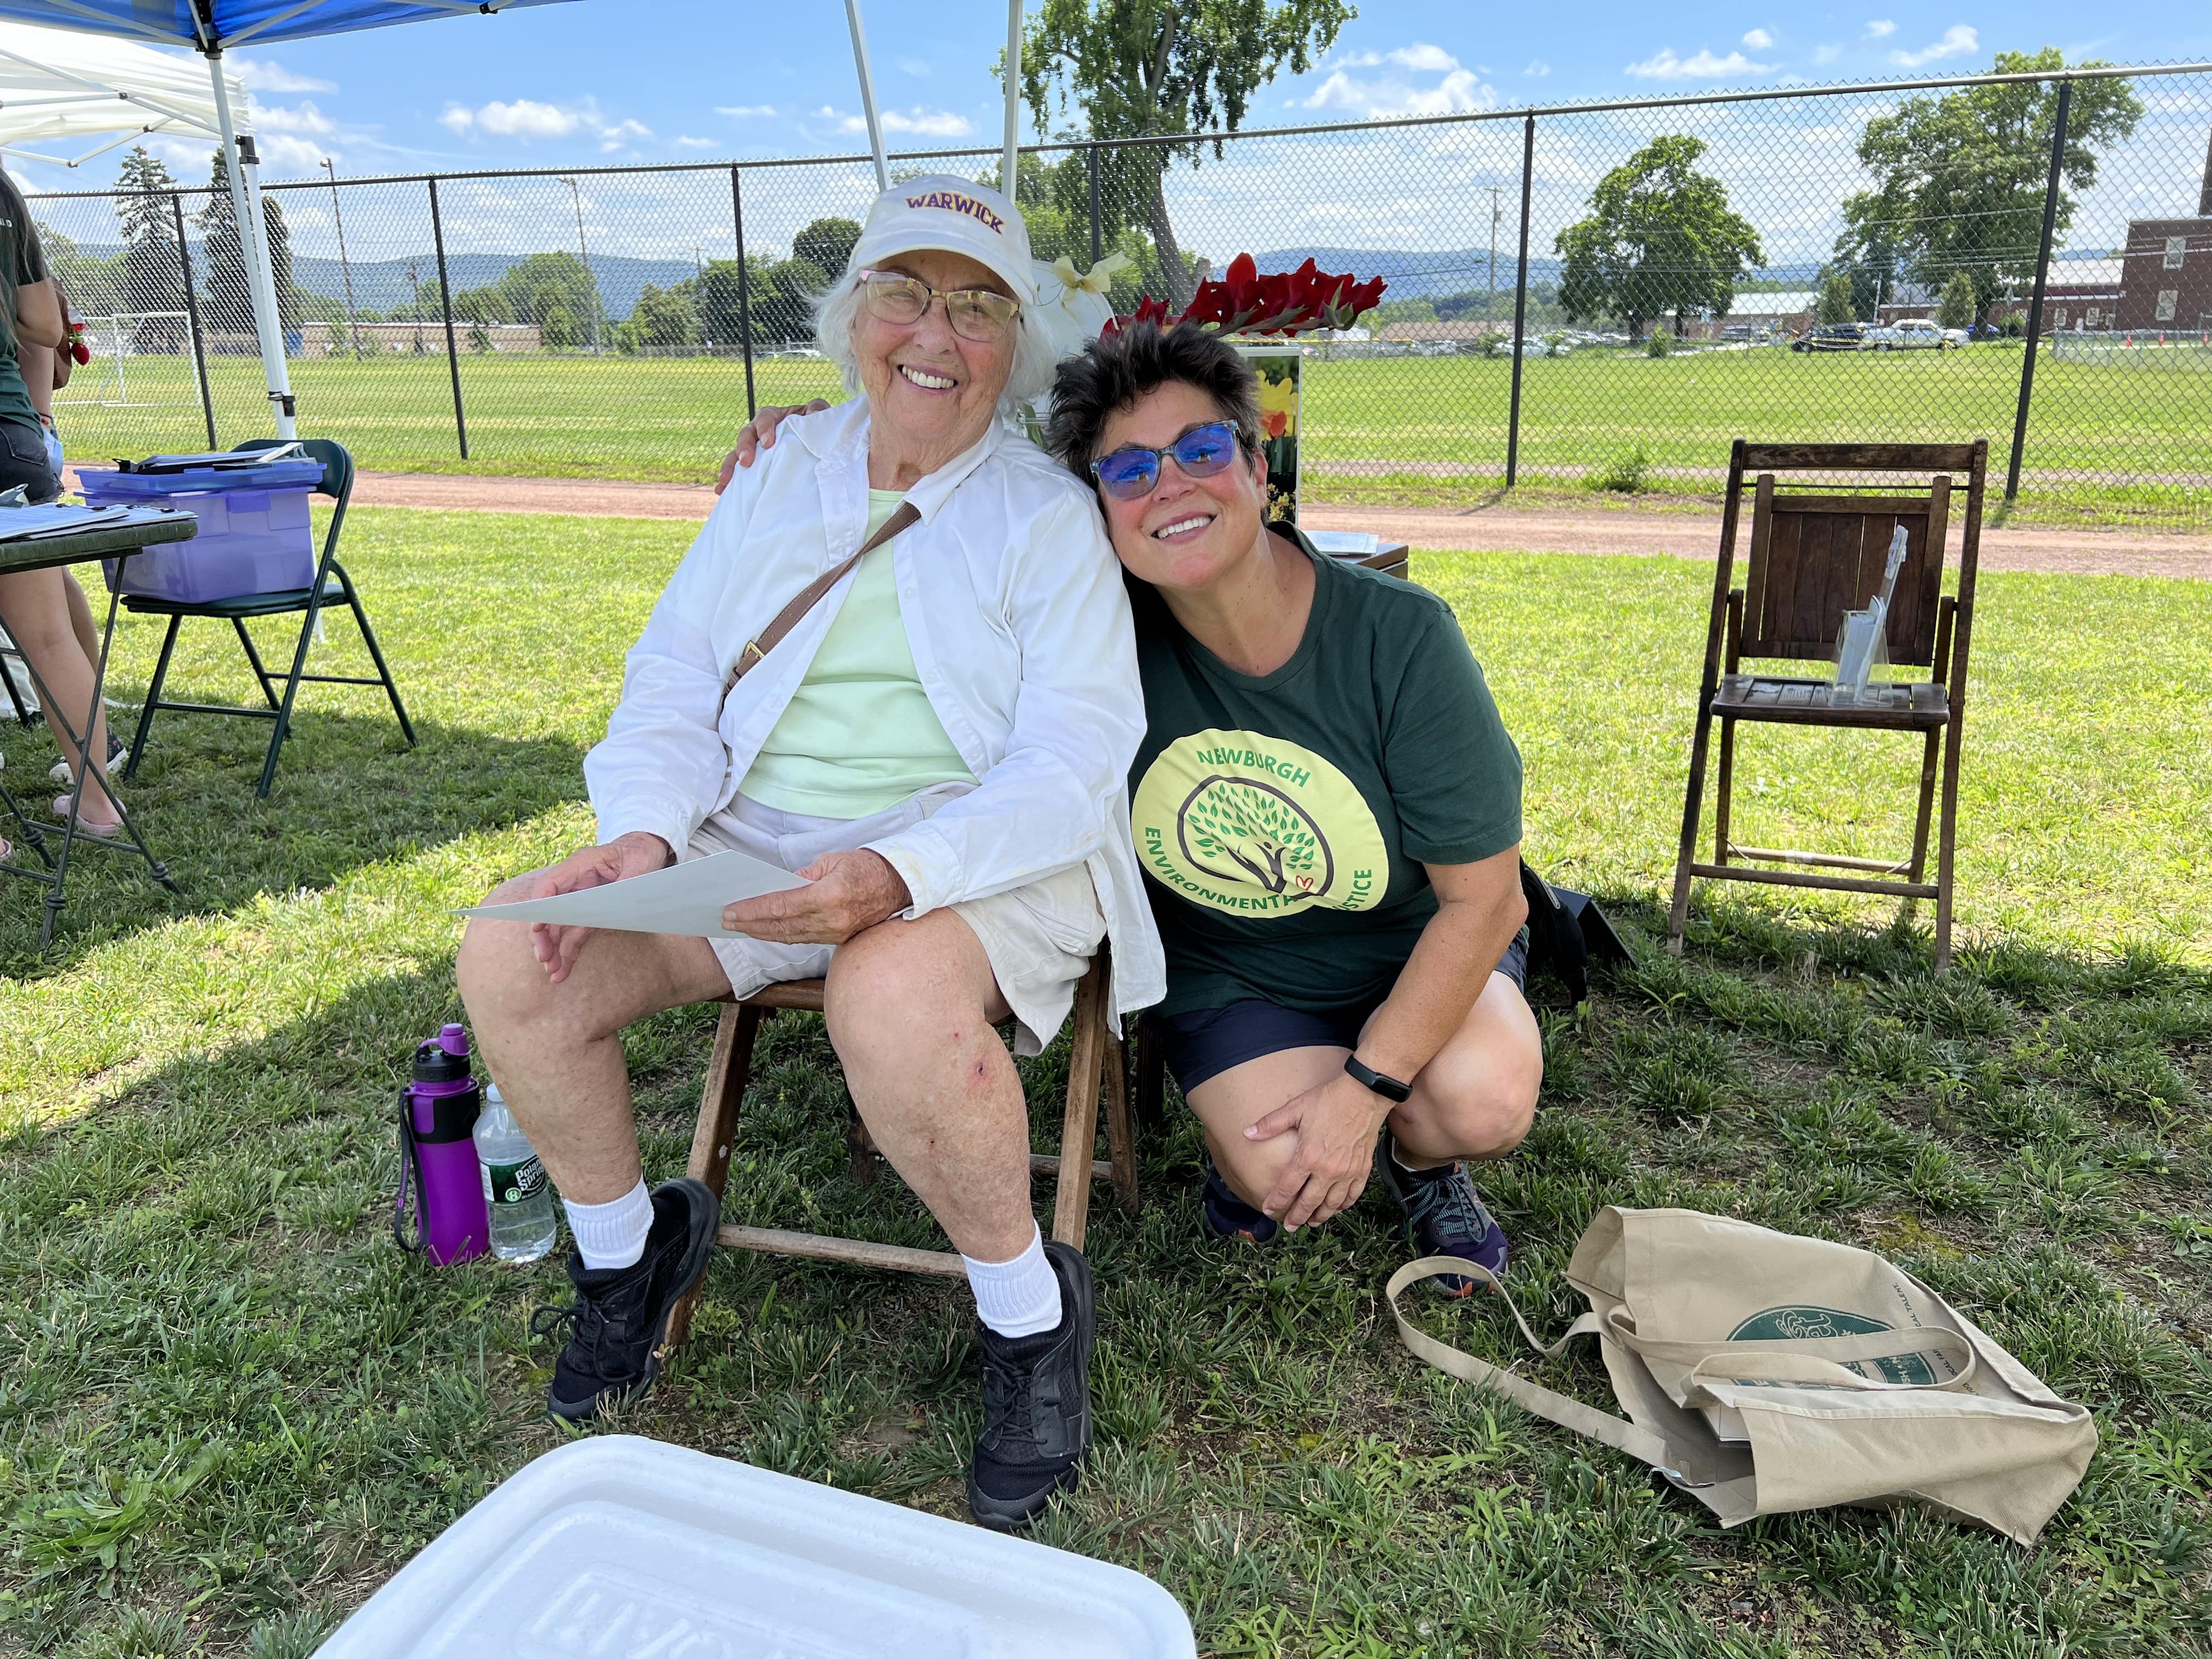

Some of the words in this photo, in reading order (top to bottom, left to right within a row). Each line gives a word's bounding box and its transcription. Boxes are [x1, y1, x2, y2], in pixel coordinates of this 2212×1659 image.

[905, 191, 1005, 236] WARWICK
[1197, 747, 1311, 788] NEWBURGH
[1145, 827, 1298, 910] ENVIRONMENTA
[1332, 869, 1372, 911] USTICE
[515, 1158, 541, 1182] Polan
[1943, 1360, 1958, 1376] OCAL
